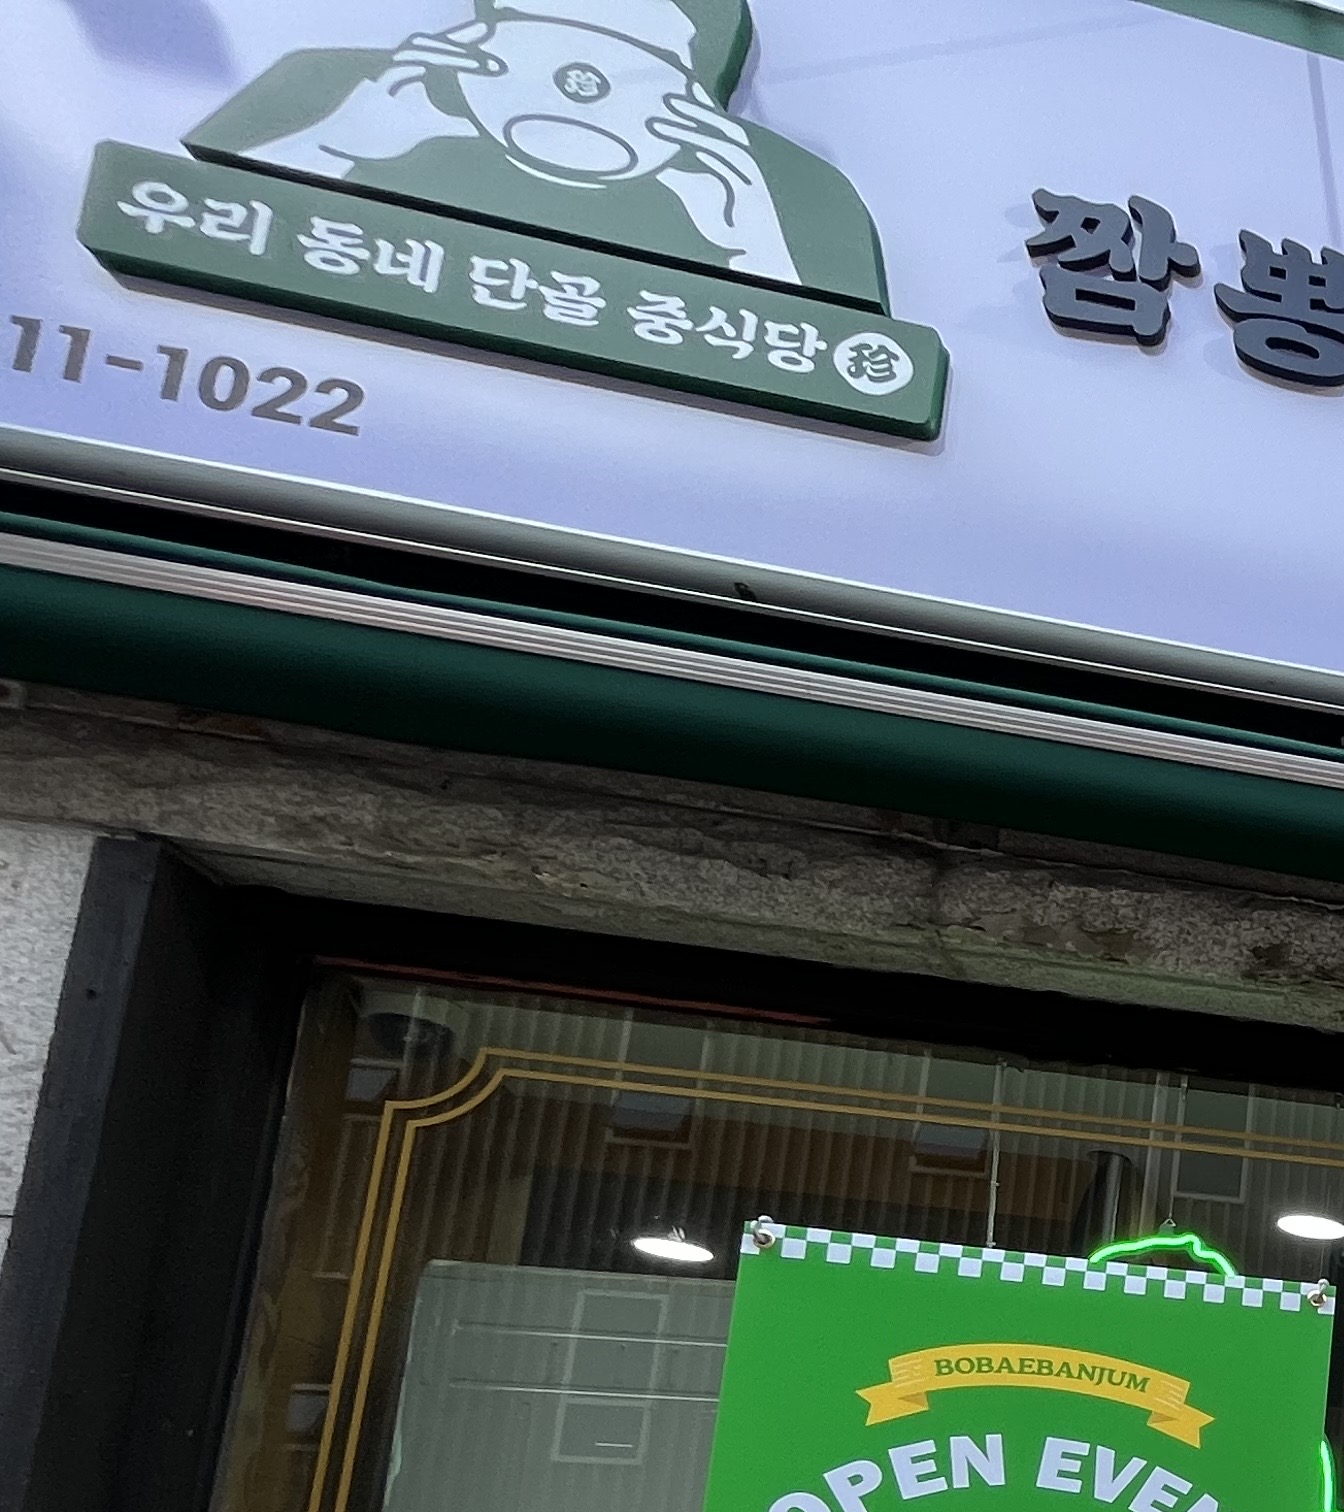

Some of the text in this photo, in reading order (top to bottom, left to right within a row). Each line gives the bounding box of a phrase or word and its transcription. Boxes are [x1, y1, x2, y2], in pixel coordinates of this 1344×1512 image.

[117, 180, 828, 373] 우리 동네 단골 중식당
[934, 1355, 1151, 1394] BOBAEBANJUM
